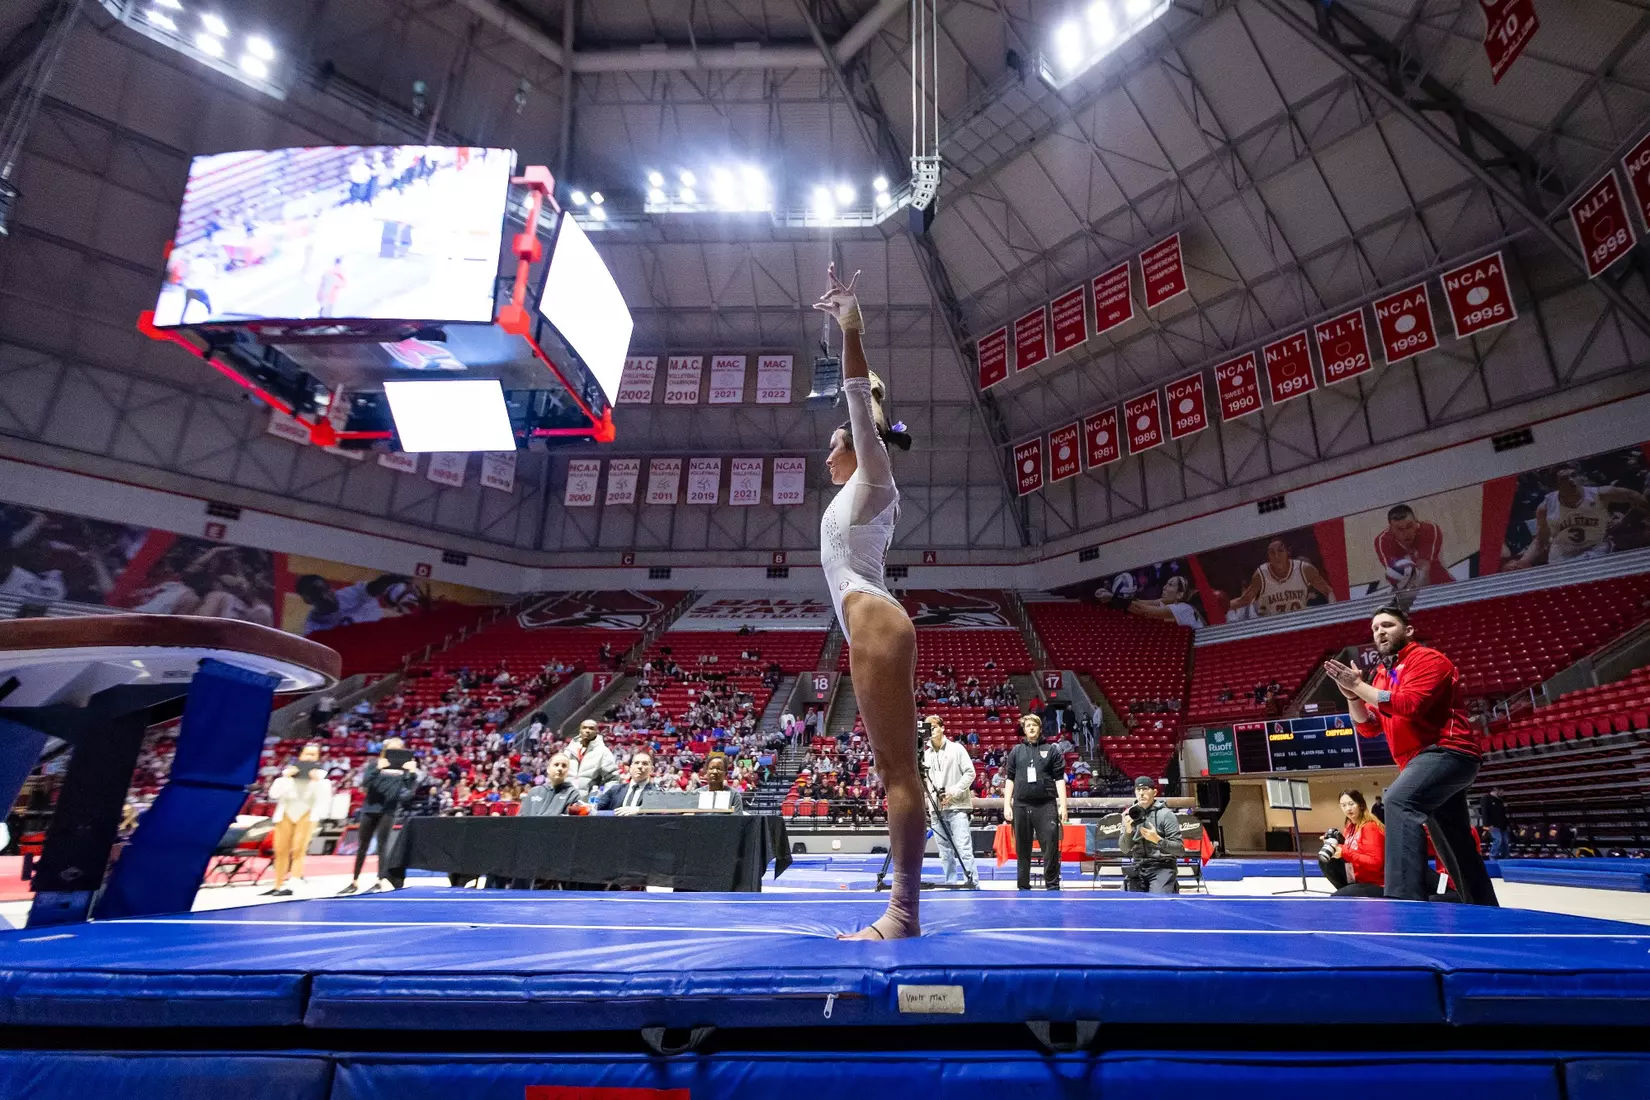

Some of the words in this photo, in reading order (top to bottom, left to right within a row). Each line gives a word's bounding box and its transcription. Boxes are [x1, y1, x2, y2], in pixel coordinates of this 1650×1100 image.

[1497, 13, 1519, 46] 10
[1578, 186, 1614, 223] N.I.T.
[1592, 228, 1628, 264] 1998
[1146, 253, 1178, 274] CONFERENCE
[1149, 263, 1178, 282] CHAMPIONS
[1447, 264, 1500, 291] NCAA
[1157, 282, 1174, 295] 1993
[1378, 294, 1426, 319] NCAA
[1463, 303, 1505, 326] 1995
[1391, 331, 1428, 352] 1993
[669, 360, 701, 370] M.A.C.
[717, 360, 740, 368] MAC
[763, 360, 787, 368] MAC
[1218, 360, 1254, 380] NCAA
[1328, 353, 1366, 376] 1992
[1277, 373, 1309, 394] 1991
[620, 391, 650, 400] 2002
[667, 391, 696, 400] 2010
[1168, 381, 1202, 401] NCAA
[1126, 399, 1157, 418] NCAA
[1228, 395, 1254, 413] 1990
[1086, 415, 1115, 432] NCAA
[1176, 413, 1201, 429] 1989
[1052, 429, 1077, 446] NCAA
[1134, 430, 1157, 445] 1986
[1017, 446, 1039, 460] NAIA
[1093, 446, 1114, 460] 1981
[568, 464, 599, 472] NCAA
[609, 463, 638, 471] NCAA
[651, 463, 680, 471] NCAA
[690, 462, 720, 470] NCAA
[732, 462, 761, 470] NCAA
[775, 462, 803, 470] NCAA
[1057, 462, 1075, 475] 1964
[1021, 474, 1039, 487] 1957
[608, 492, 632, 500] 2002
[652, 492, 673, 500] 2011
[691, 492, 715, 500] 2019
[734, 490, 757, 498] 2021
[1568, 528, 1585, 542] 3
[624, 555, 632, 564] C
[775, 555, 783, 563] B
[926, 554, 933, 562] A
[812, 678, 828, 690] 18
[1045, 676, 1060, 688] 17
[1208, 742, 1232, 751] Ruoff
